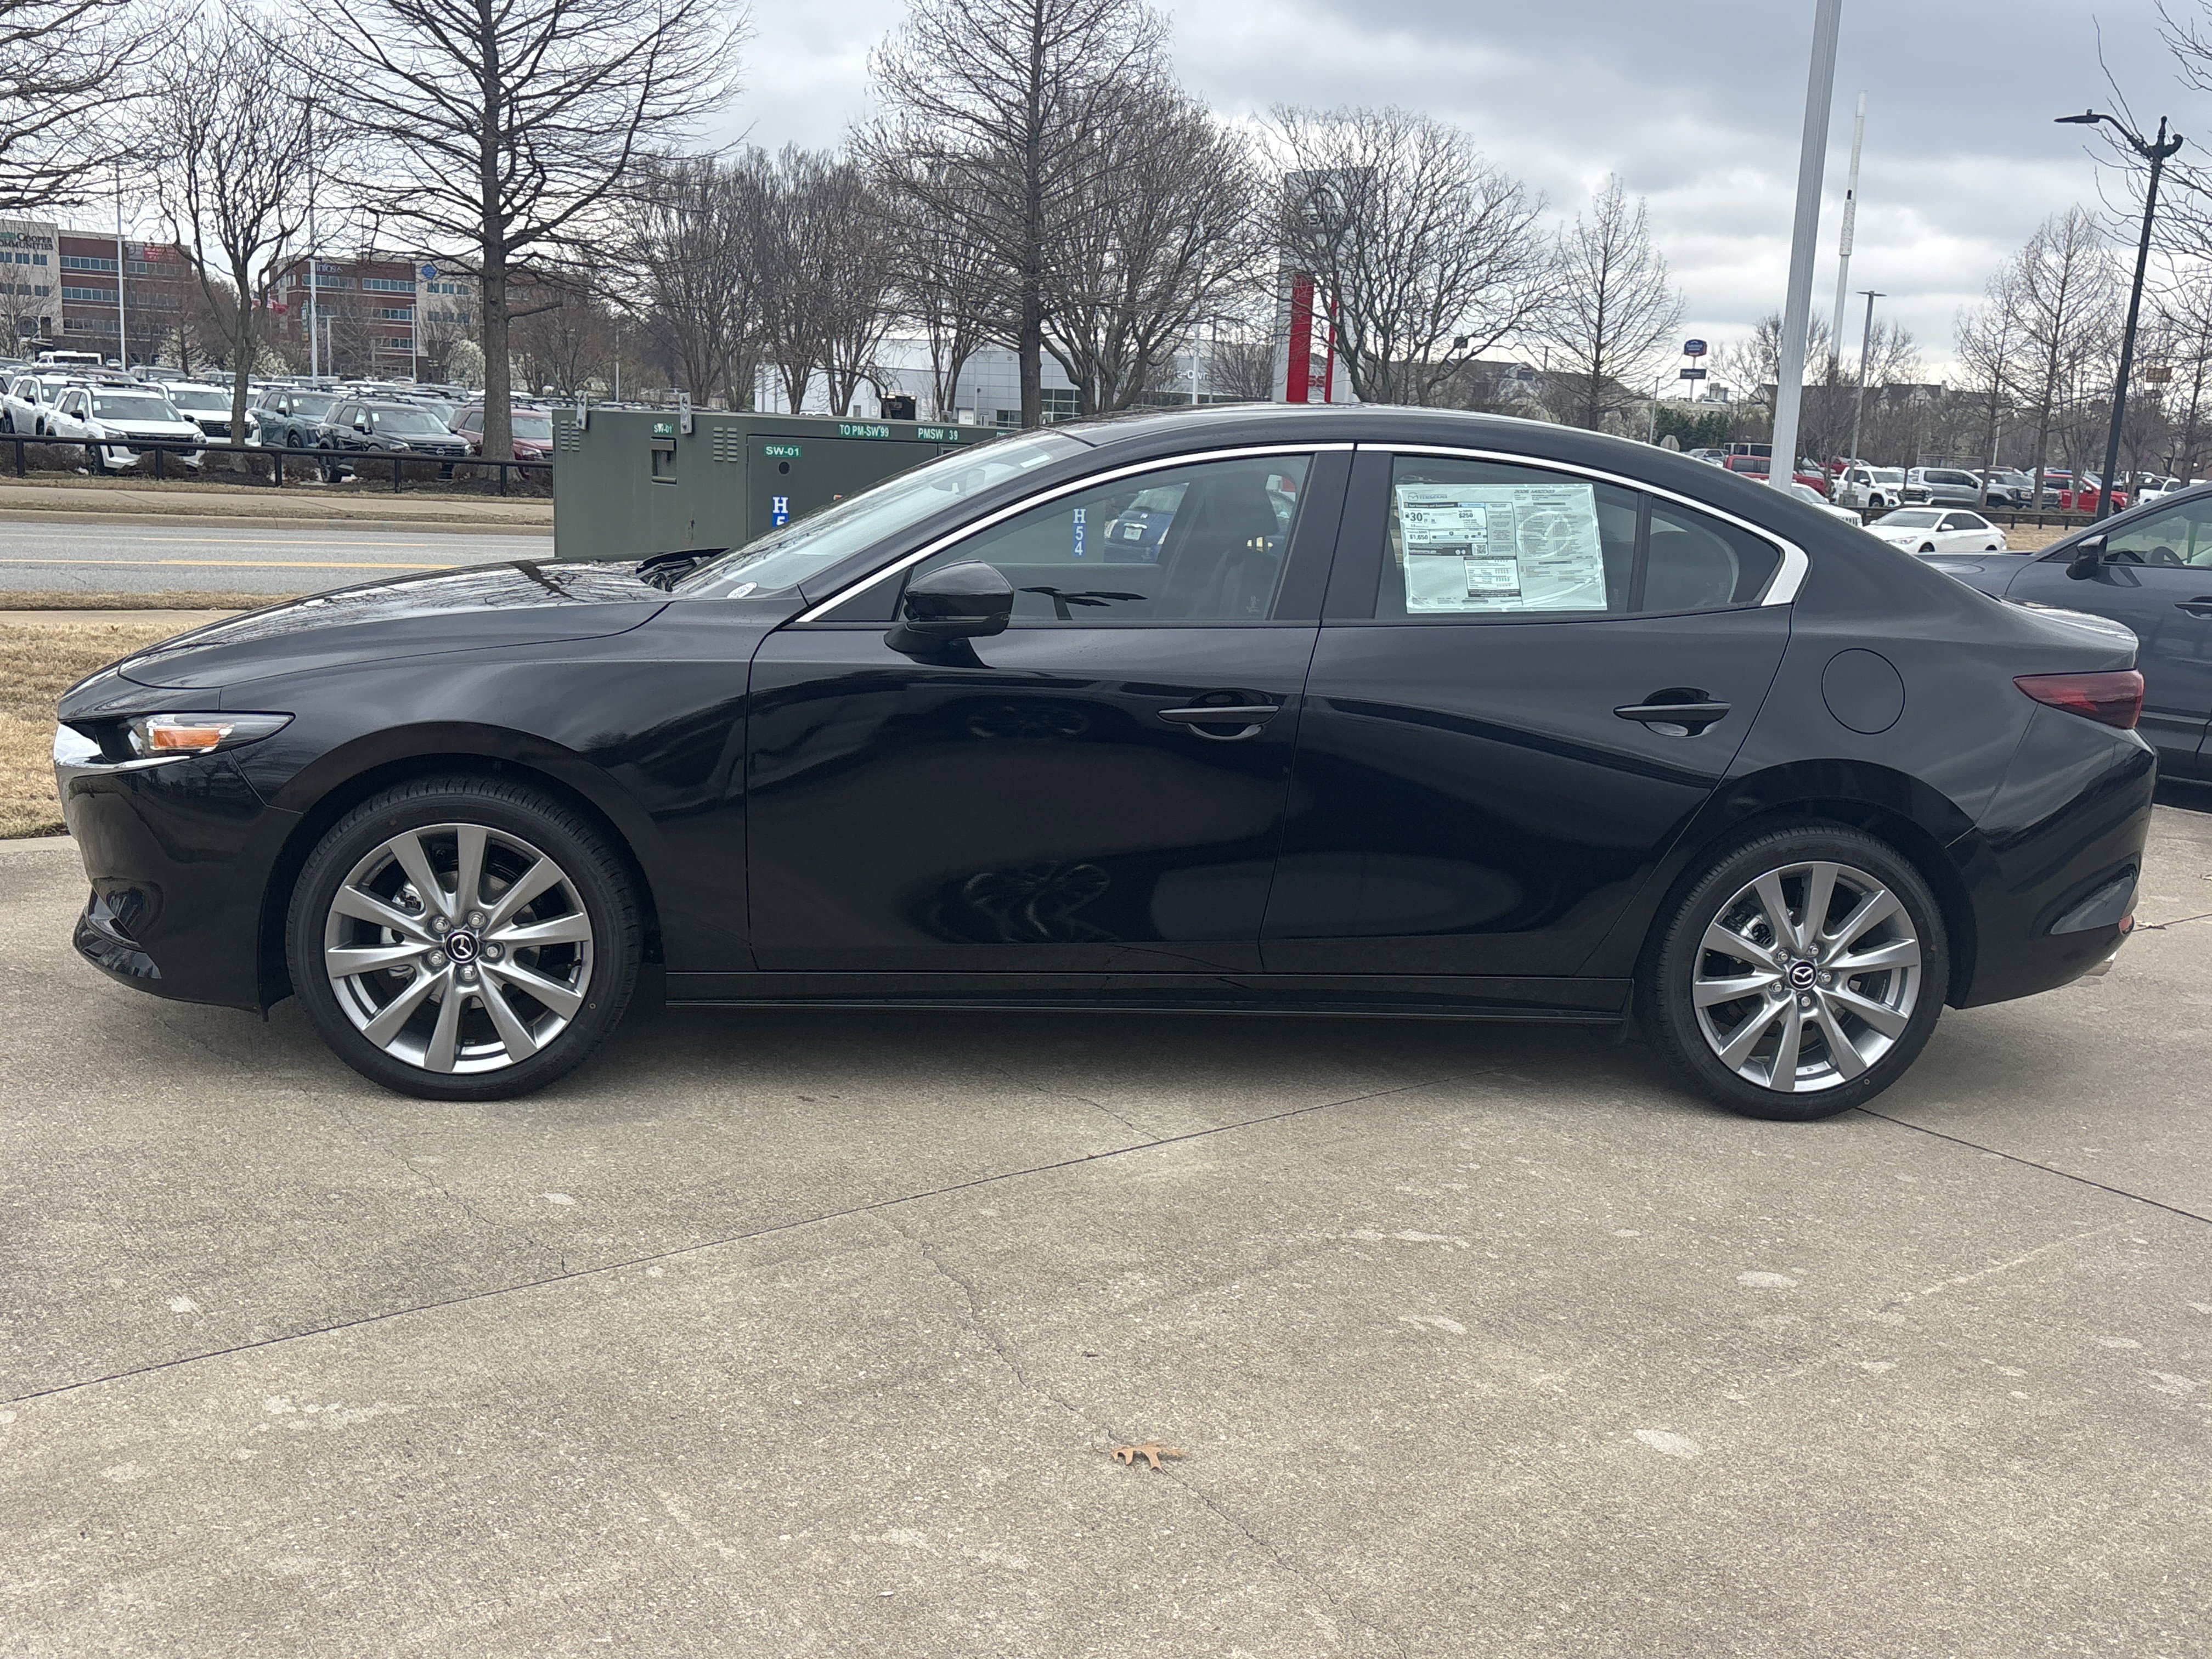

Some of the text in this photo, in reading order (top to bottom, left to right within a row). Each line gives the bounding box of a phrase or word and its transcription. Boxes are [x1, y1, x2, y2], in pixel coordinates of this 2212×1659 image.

[0, 240, 53, 250] OMMUNITIES
[839, 424, 851, 435] TO
[918, 427, 958, 441] PMSW 39
[766, 447, 799, 456] SW-01
[1410, 512, 1423, 521] 30
